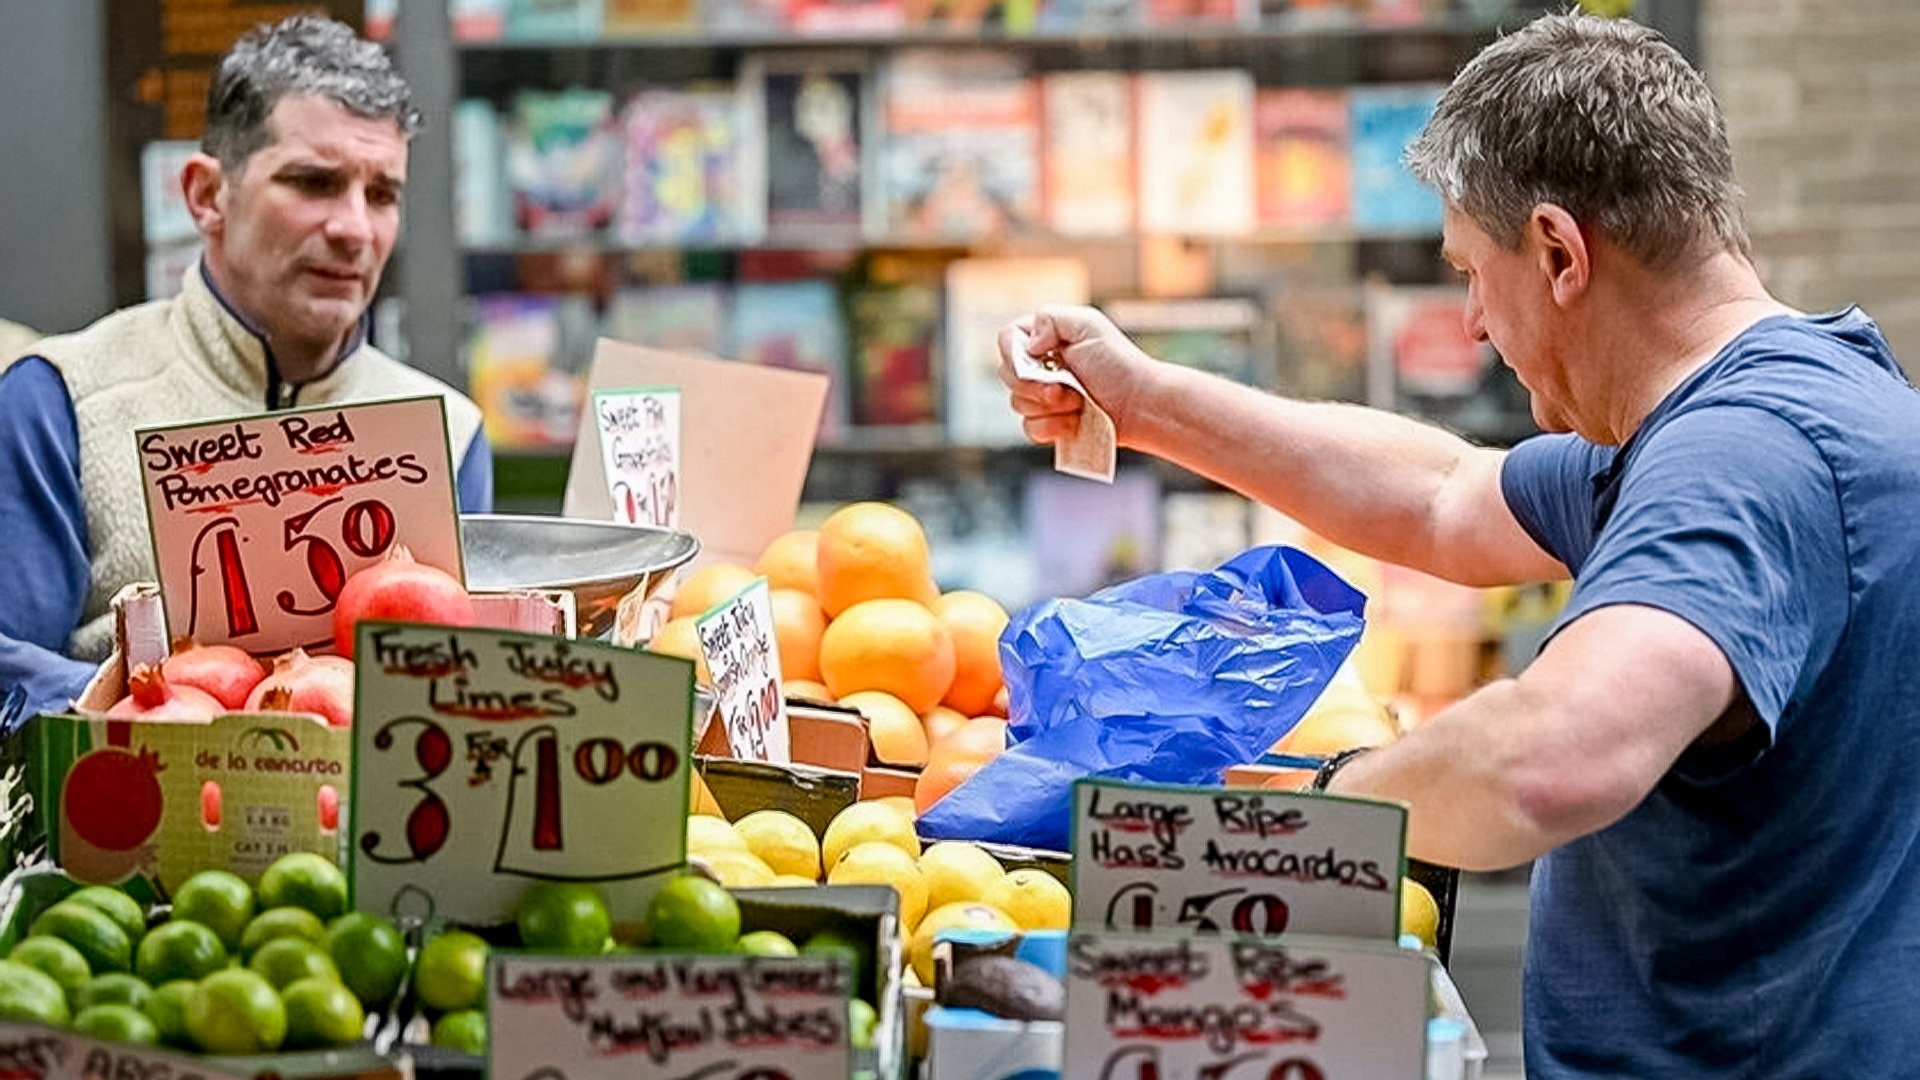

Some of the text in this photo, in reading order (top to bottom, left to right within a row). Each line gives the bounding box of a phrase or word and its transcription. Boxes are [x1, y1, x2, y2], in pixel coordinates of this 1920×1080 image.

[141, 411, 355, 472] Sweet Red
[155, 453, 428, 510] Pomegranates
[370, 628, 620, 702] Fresh Juicy
[428, 677, 577, 717] Limes
[195, 749, 219, 770] de
[227, 751, 246, 771] la
[361, 716, 453, 865] 3
[1088, 789, 1309, 848] Large Ripe
[1091, 832, 1185, 870] Hass
